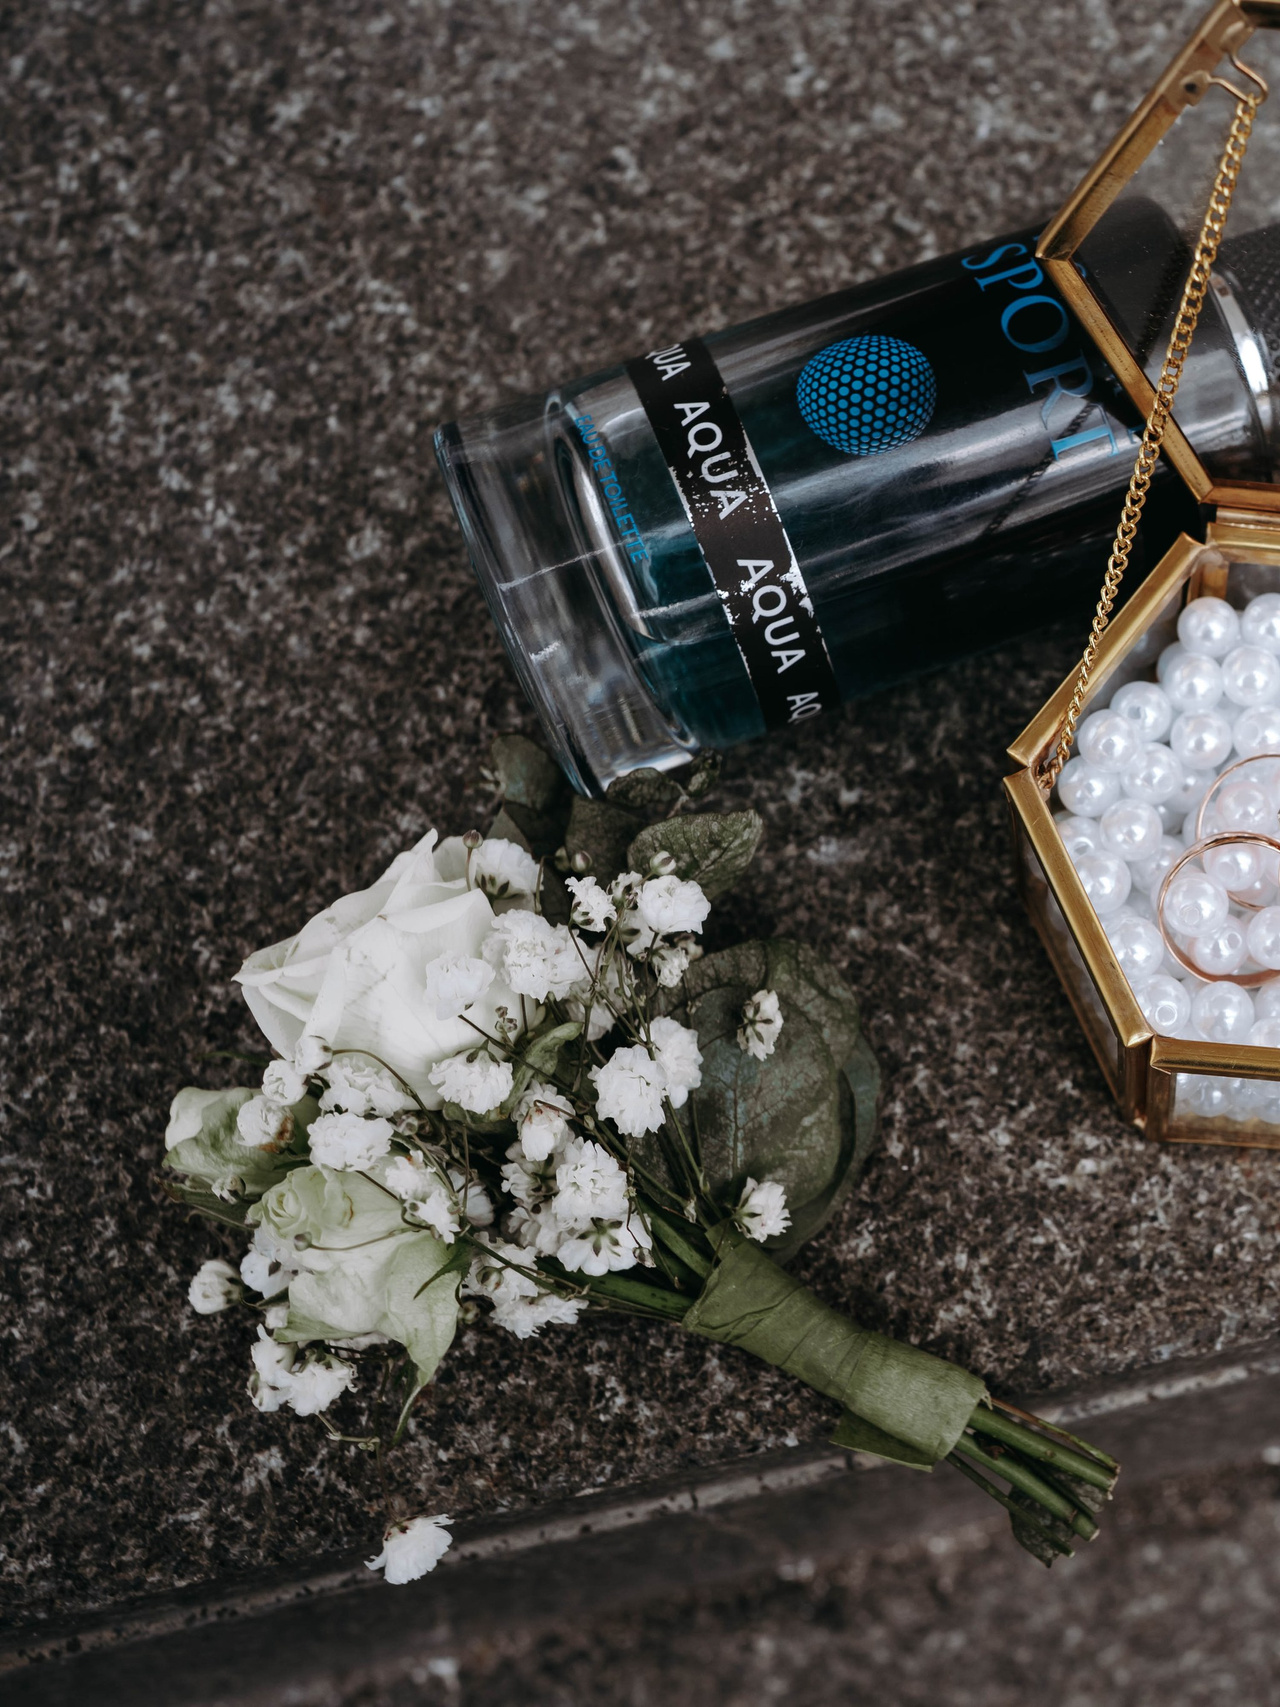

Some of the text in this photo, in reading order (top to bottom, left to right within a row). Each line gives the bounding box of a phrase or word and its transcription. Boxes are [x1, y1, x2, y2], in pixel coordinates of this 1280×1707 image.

[961, 243, 1119, 461] SPORT
[575, 414, 649, 564] EAU DE TOILETTE
[673, 401, 749, 520] AQUA
[737, 559, 806, 674] AQUA
